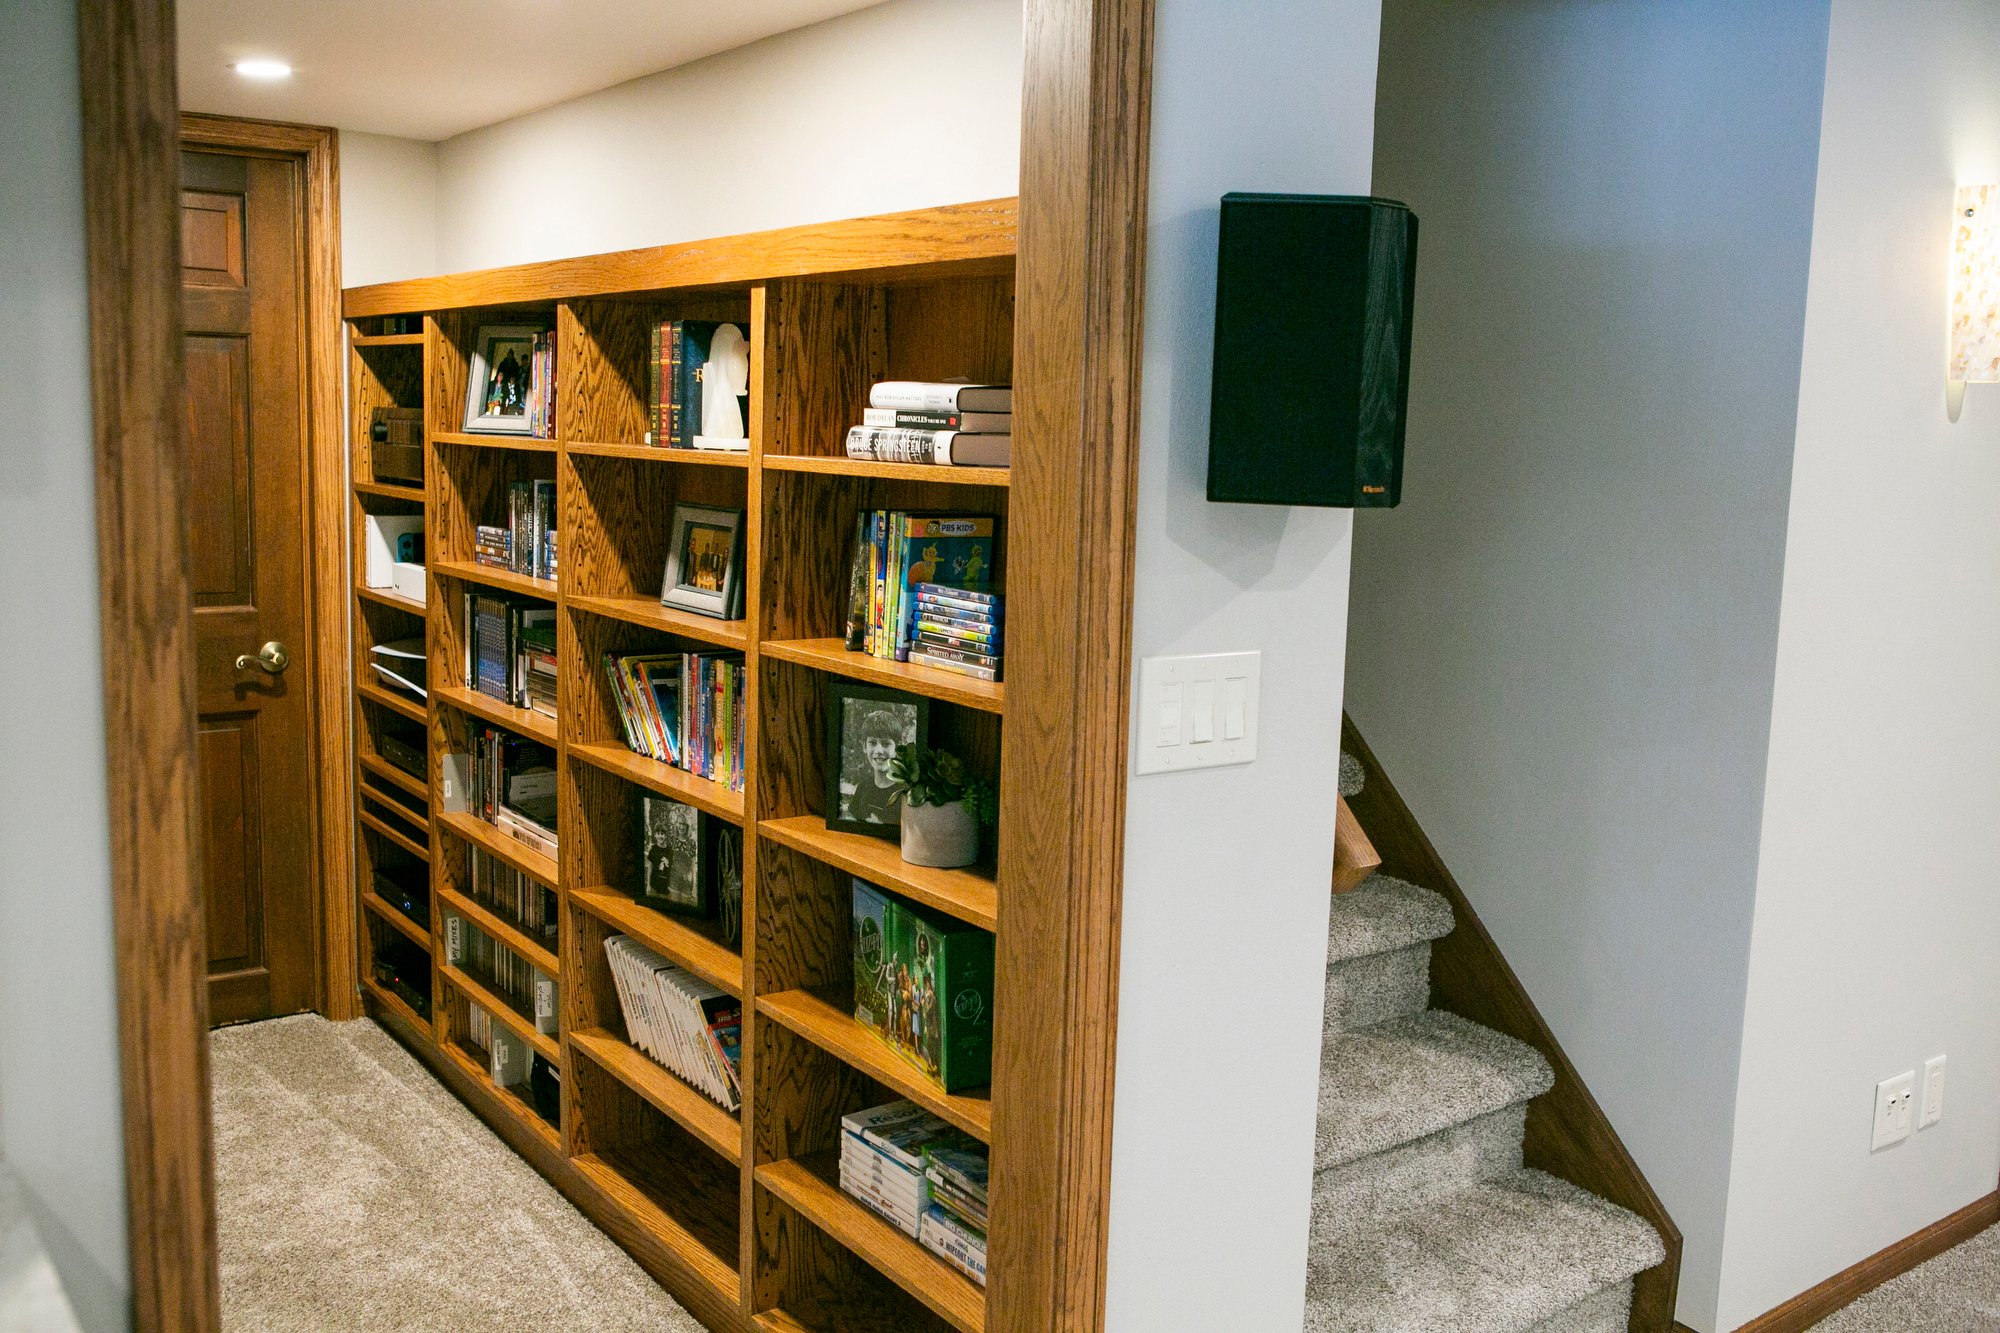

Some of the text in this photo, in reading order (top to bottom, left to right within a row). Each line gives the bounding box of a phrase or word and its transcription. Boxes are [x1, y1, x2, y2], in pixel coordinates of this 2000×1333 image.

[897, 414, 928, 424] CHRONICLES
[874, 438, 920, 453] SPRINGSTEEN
[941, 524, 975, 532] PBS KIDS
[926, 646, 949, 659] SPIRITED
